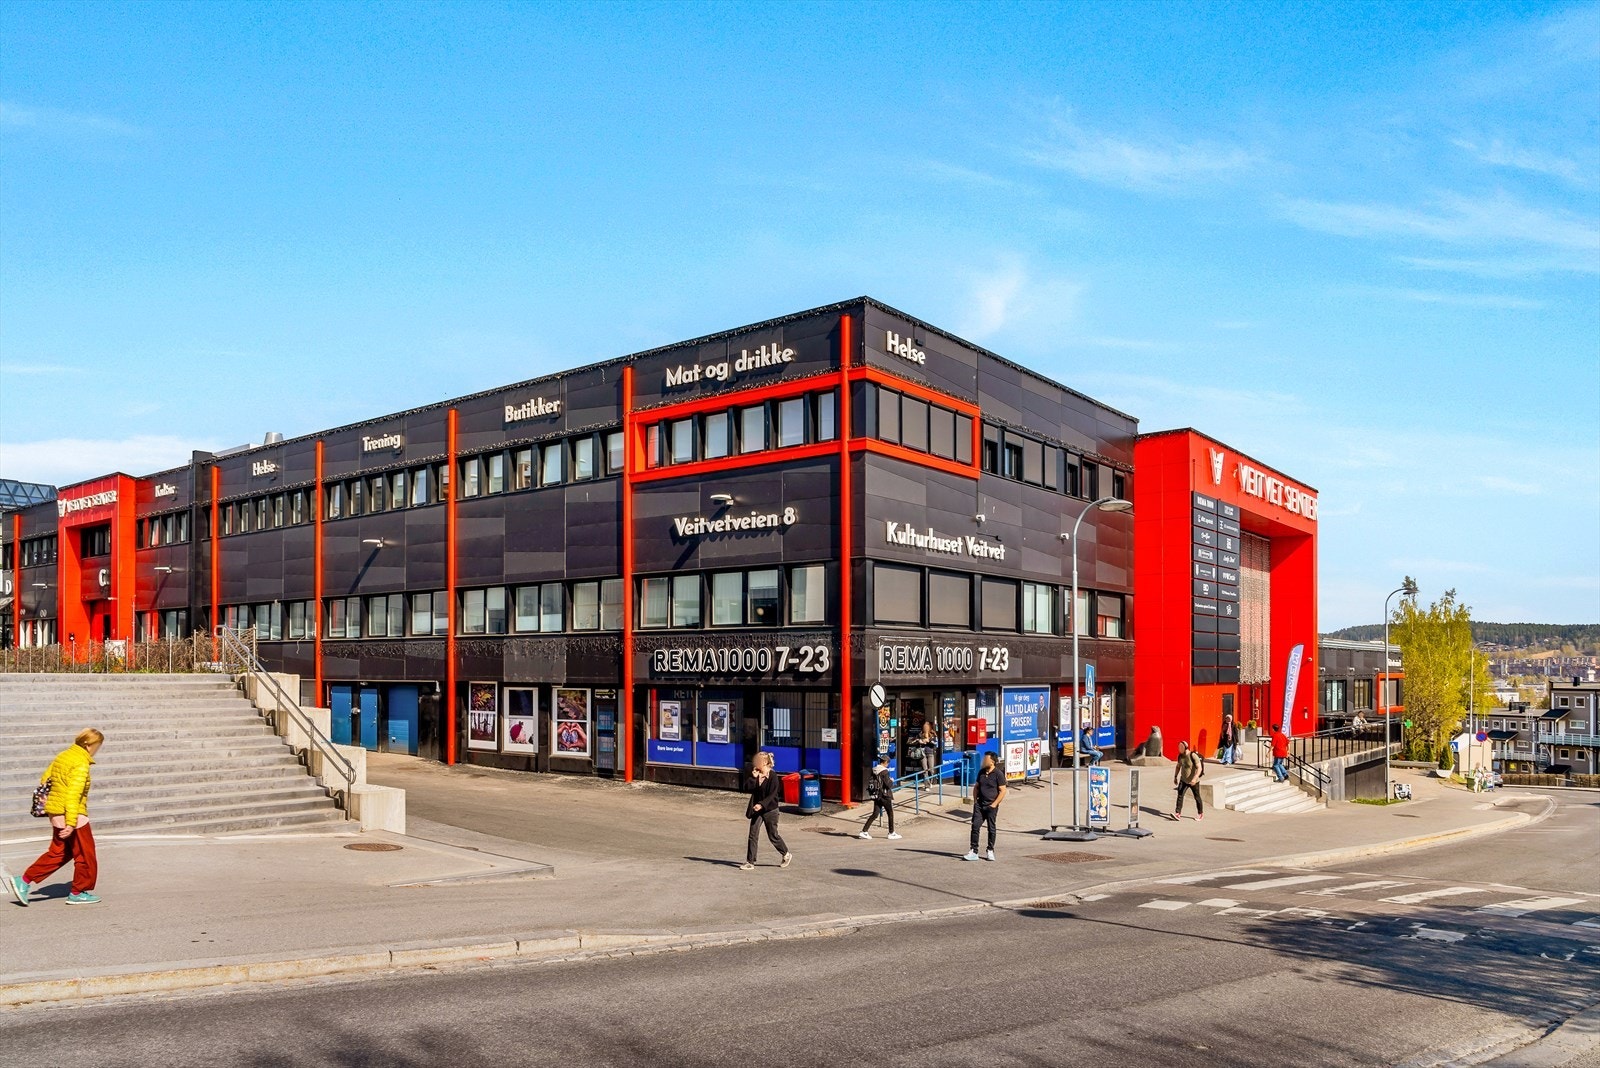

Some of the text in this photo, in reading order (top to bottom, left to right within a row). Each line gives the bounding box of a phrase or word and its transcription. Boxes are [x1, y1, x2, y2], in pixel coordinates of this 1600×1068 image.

[886, 330, 926, 365] Helse
[666, 342, 795, 387] Mat og drikke
[504, 396, 560, 423] Butikker
[362, 433, 401, 452] Trening
[252, 459, 276, 476] Helse
[1237, 461, 1285, 507] VEITVET
[674, 506, 797, 537] Veitvetveien 8
[886, 521, 1006, 561] Kulturhuset Veitvet
[653, 646, 831, 673] REMA 1000 7-23
[879, 644, 1009, 671] REMA 1000 7-23
[1005, 703, 1038, 715] ALLTID LAVE
[1010, 716, 1032, 728] PRISER!
